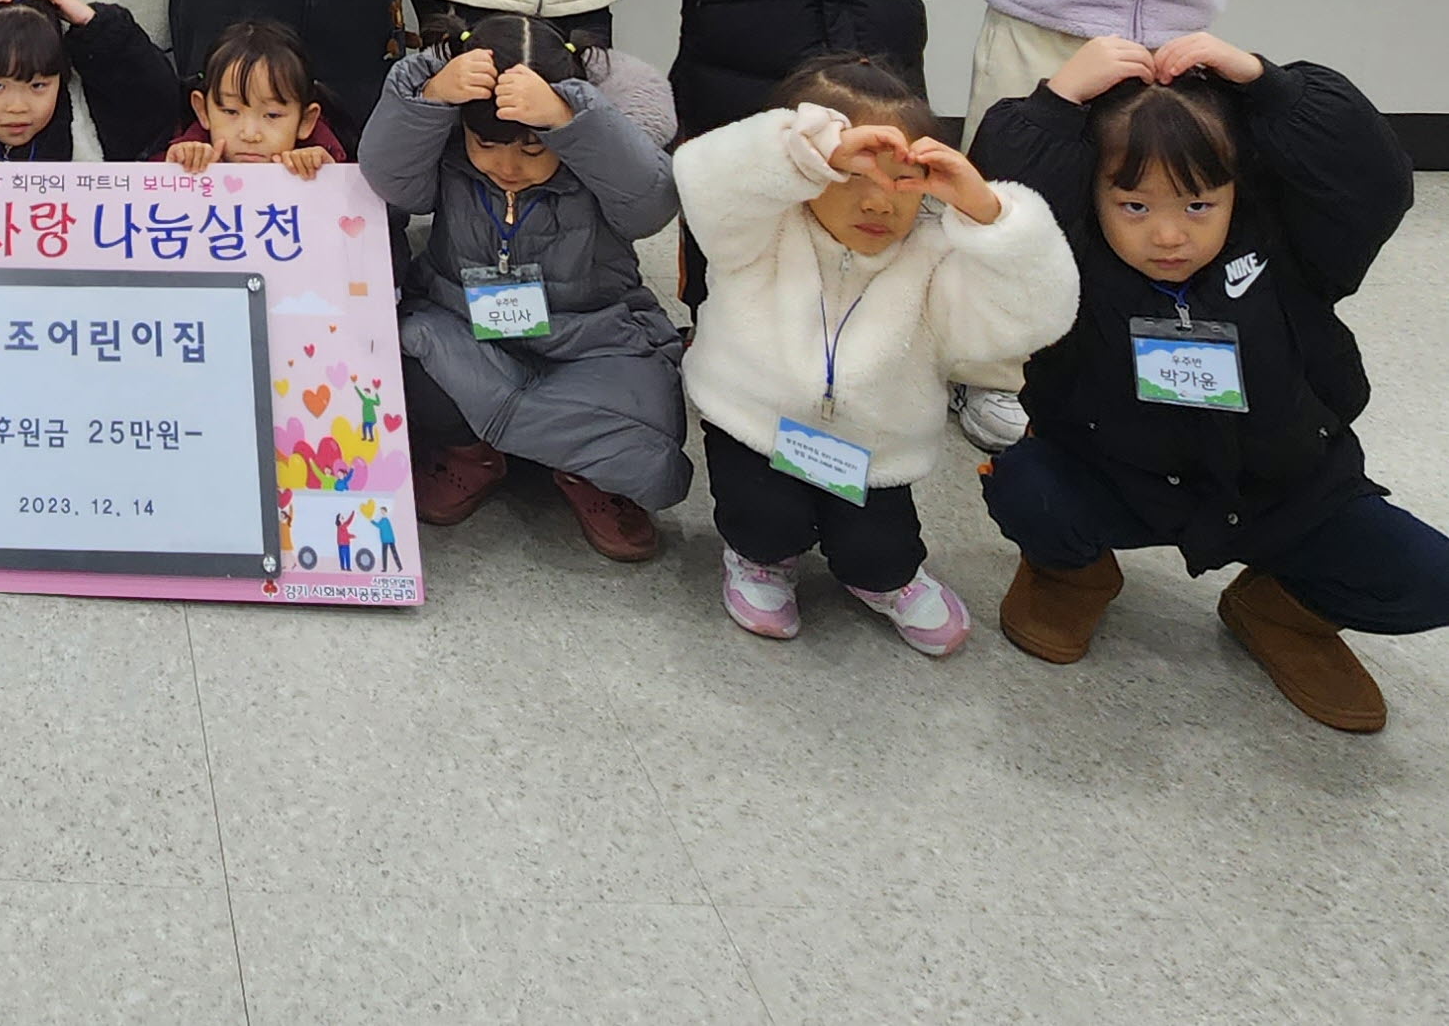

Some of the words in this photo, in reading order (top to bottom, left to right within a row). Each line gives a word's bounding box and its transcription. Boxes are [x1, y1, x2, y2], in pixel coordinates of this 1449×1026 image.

[12, 174, 66, 194] 희망의
[76, 175, 131, 193] 파트너
[142, 175, 215, 198] 보니마을
[93, 202, 305, 262] 나눔실천
[1225, 252, 1258, 283] NIKE
[1172, 354, 1203, 369] 우주반
[1159, 368, 1219, 392] 박가윤
[19, 496, 80, 516] 2023.
[91, 498, 121, 517] 12.
[133, 499, 155, 516] 14
[285, 585, 309, 601] 경기
